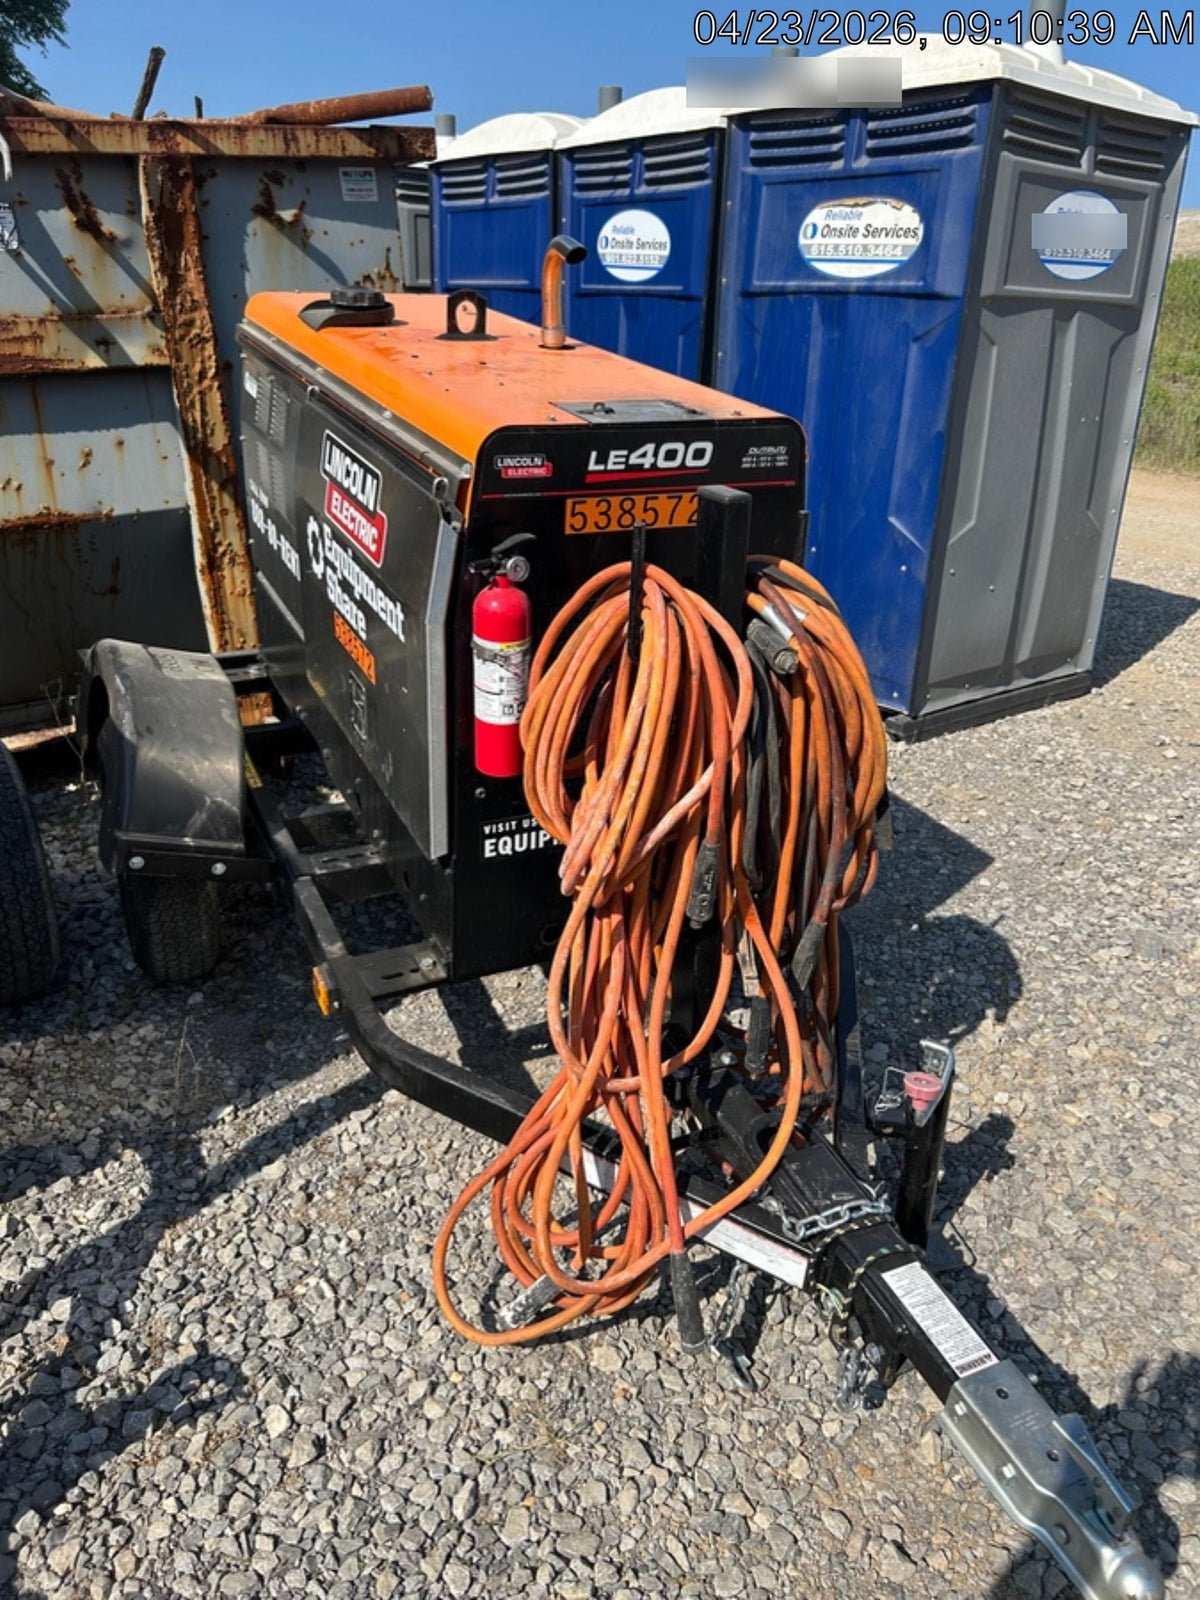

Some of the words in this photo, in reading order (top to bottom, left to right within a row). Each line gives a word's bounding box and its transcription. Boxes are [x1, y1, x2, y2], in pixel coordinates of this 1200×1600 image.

[824, 208, 863, 221] Reliable
[820, 223, 860, 239] Onsite
[862, 223, 919, 240] Services
[610, 237, 634, 250] Onsite
[635, 237, 668, 251] Services
[809, 244, 903, 257] 615.510.3464
[496, 456, 543, 468] LINCOLN
[587, 441, 714, 472] LE400
[324, 439, 378, 513] LINCOLN
[506, 466, 548, 477] ELECTRIC
[330, 489, 379, 553] ELECTRIC
[568, 492, 699, 533] 538572
[322, 521, 406, 644] Equipment
[325, 564, 368, 642] Share
[483, 820, 518, 835] VISIT
[484, 830, 559, 859] EQUIP
